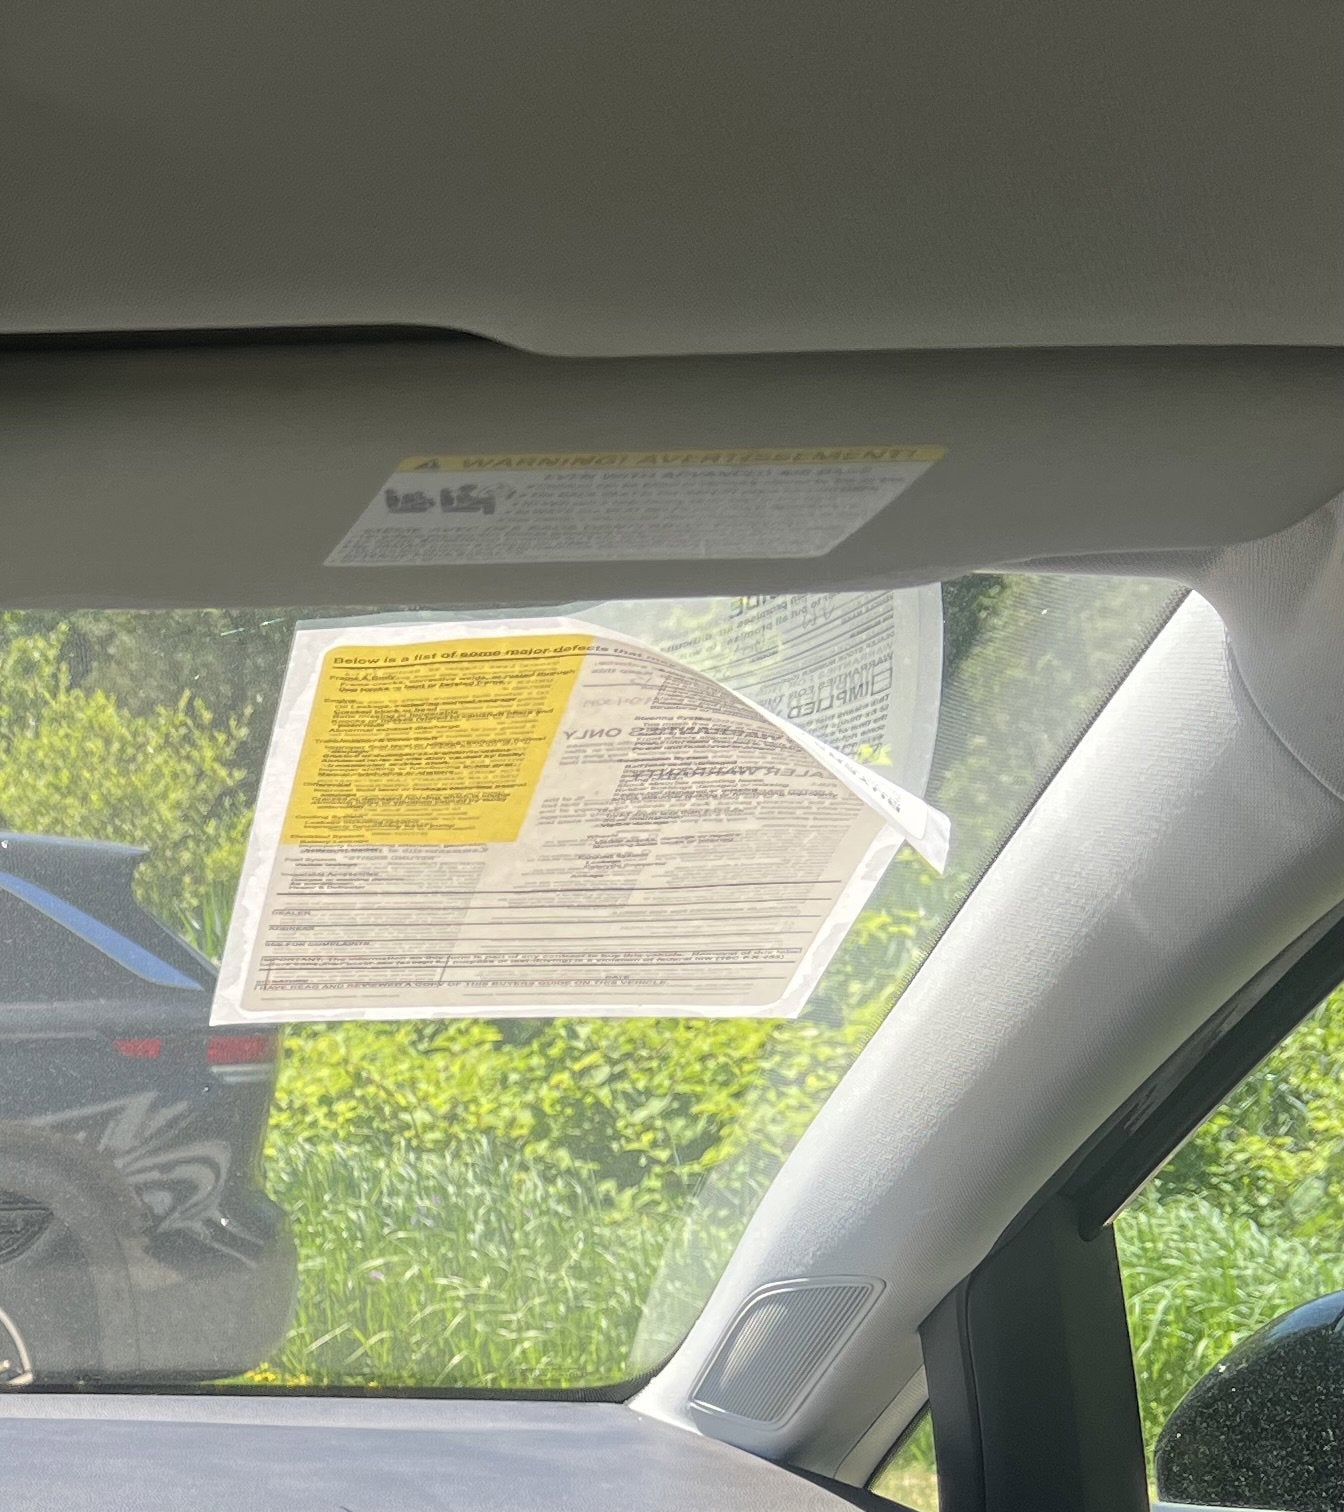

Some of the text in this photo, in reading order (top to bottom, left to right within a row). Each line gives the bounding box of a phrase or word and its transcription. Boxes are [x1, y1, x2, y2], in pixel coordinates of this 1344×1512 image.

[333, 655, 379, 666] Below
[383, 655, 396, 664] is
[399, 655, 409, 664] a
[414, 651, 435, 662] list
[440, 650, 457, 661] of
[458, 649, 502, 659] some
